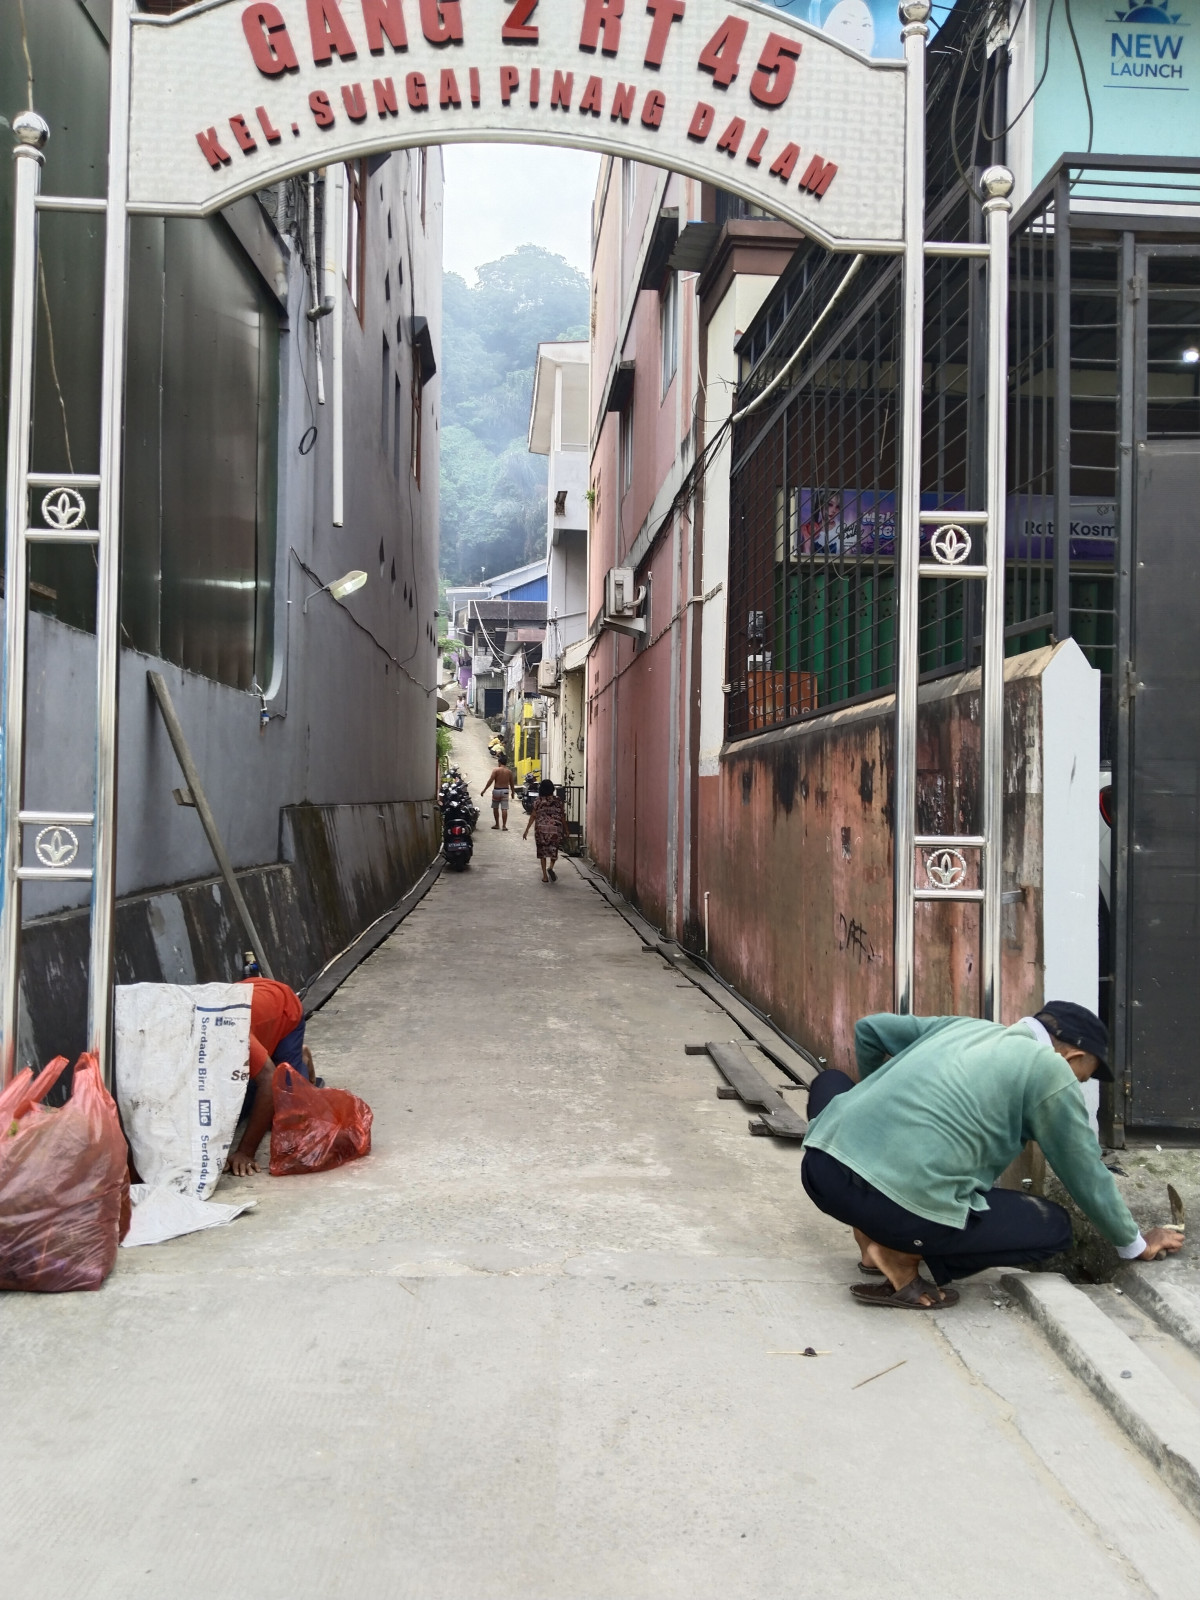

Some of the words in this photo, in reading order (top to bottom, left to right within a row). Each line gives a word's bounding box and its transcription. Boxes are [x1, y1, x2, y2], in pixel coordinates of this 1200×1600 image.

[241, 0, 463, 75] GANG
[1110, 32, 1184, 60] NEW
[1110, 62, 1183, 79] LAUNCH
[195, 105, 300, 170] KEL.
[308, 67, 481, 129] SUNGAI
[499, 66, 668, 129] PINANG
[687, 102, 839, 199] DALAM
[198, 1016, 210, 1064] Serdadu
[198, 1067, 208, 1092] Biru
[199, 1101, 211, 1125] Mie
[200, 1134, 210, 1180] Serdadu
